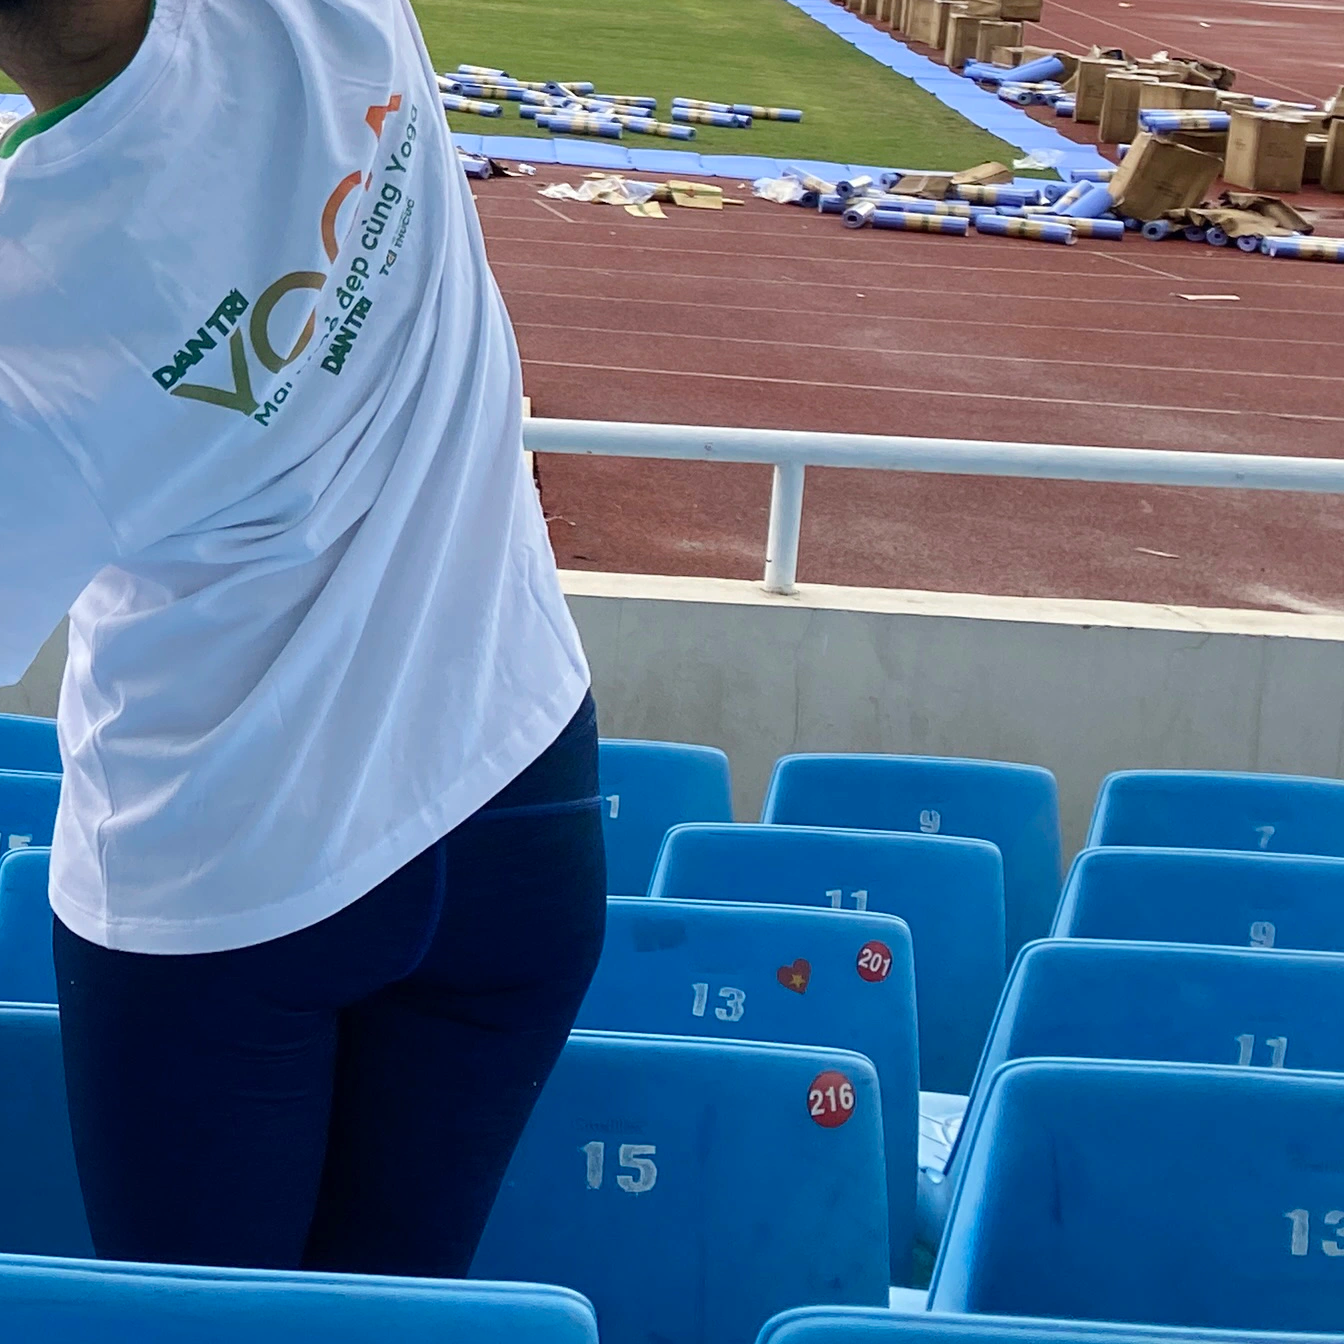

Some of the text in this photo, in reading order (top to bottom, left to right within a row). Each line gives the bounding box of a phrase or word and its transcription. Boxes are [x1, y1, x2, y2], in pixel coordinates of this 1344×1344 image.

[335, 256, 370, 310] đẹp
[360, 182, 403, 251] cùng
[918, 809, 942, 834] 9
[1249, 921, 1277, 949] 9
[858, 947, 892, 977] 201
[691, 982, 747, 1023] 13
[1234, 1033, 1289, 1069] 11
[808, 1082, 855, 1117] 216
[579, 1140, 658, 1194] 15
[1283, 1208, 1344, 1257] 13
